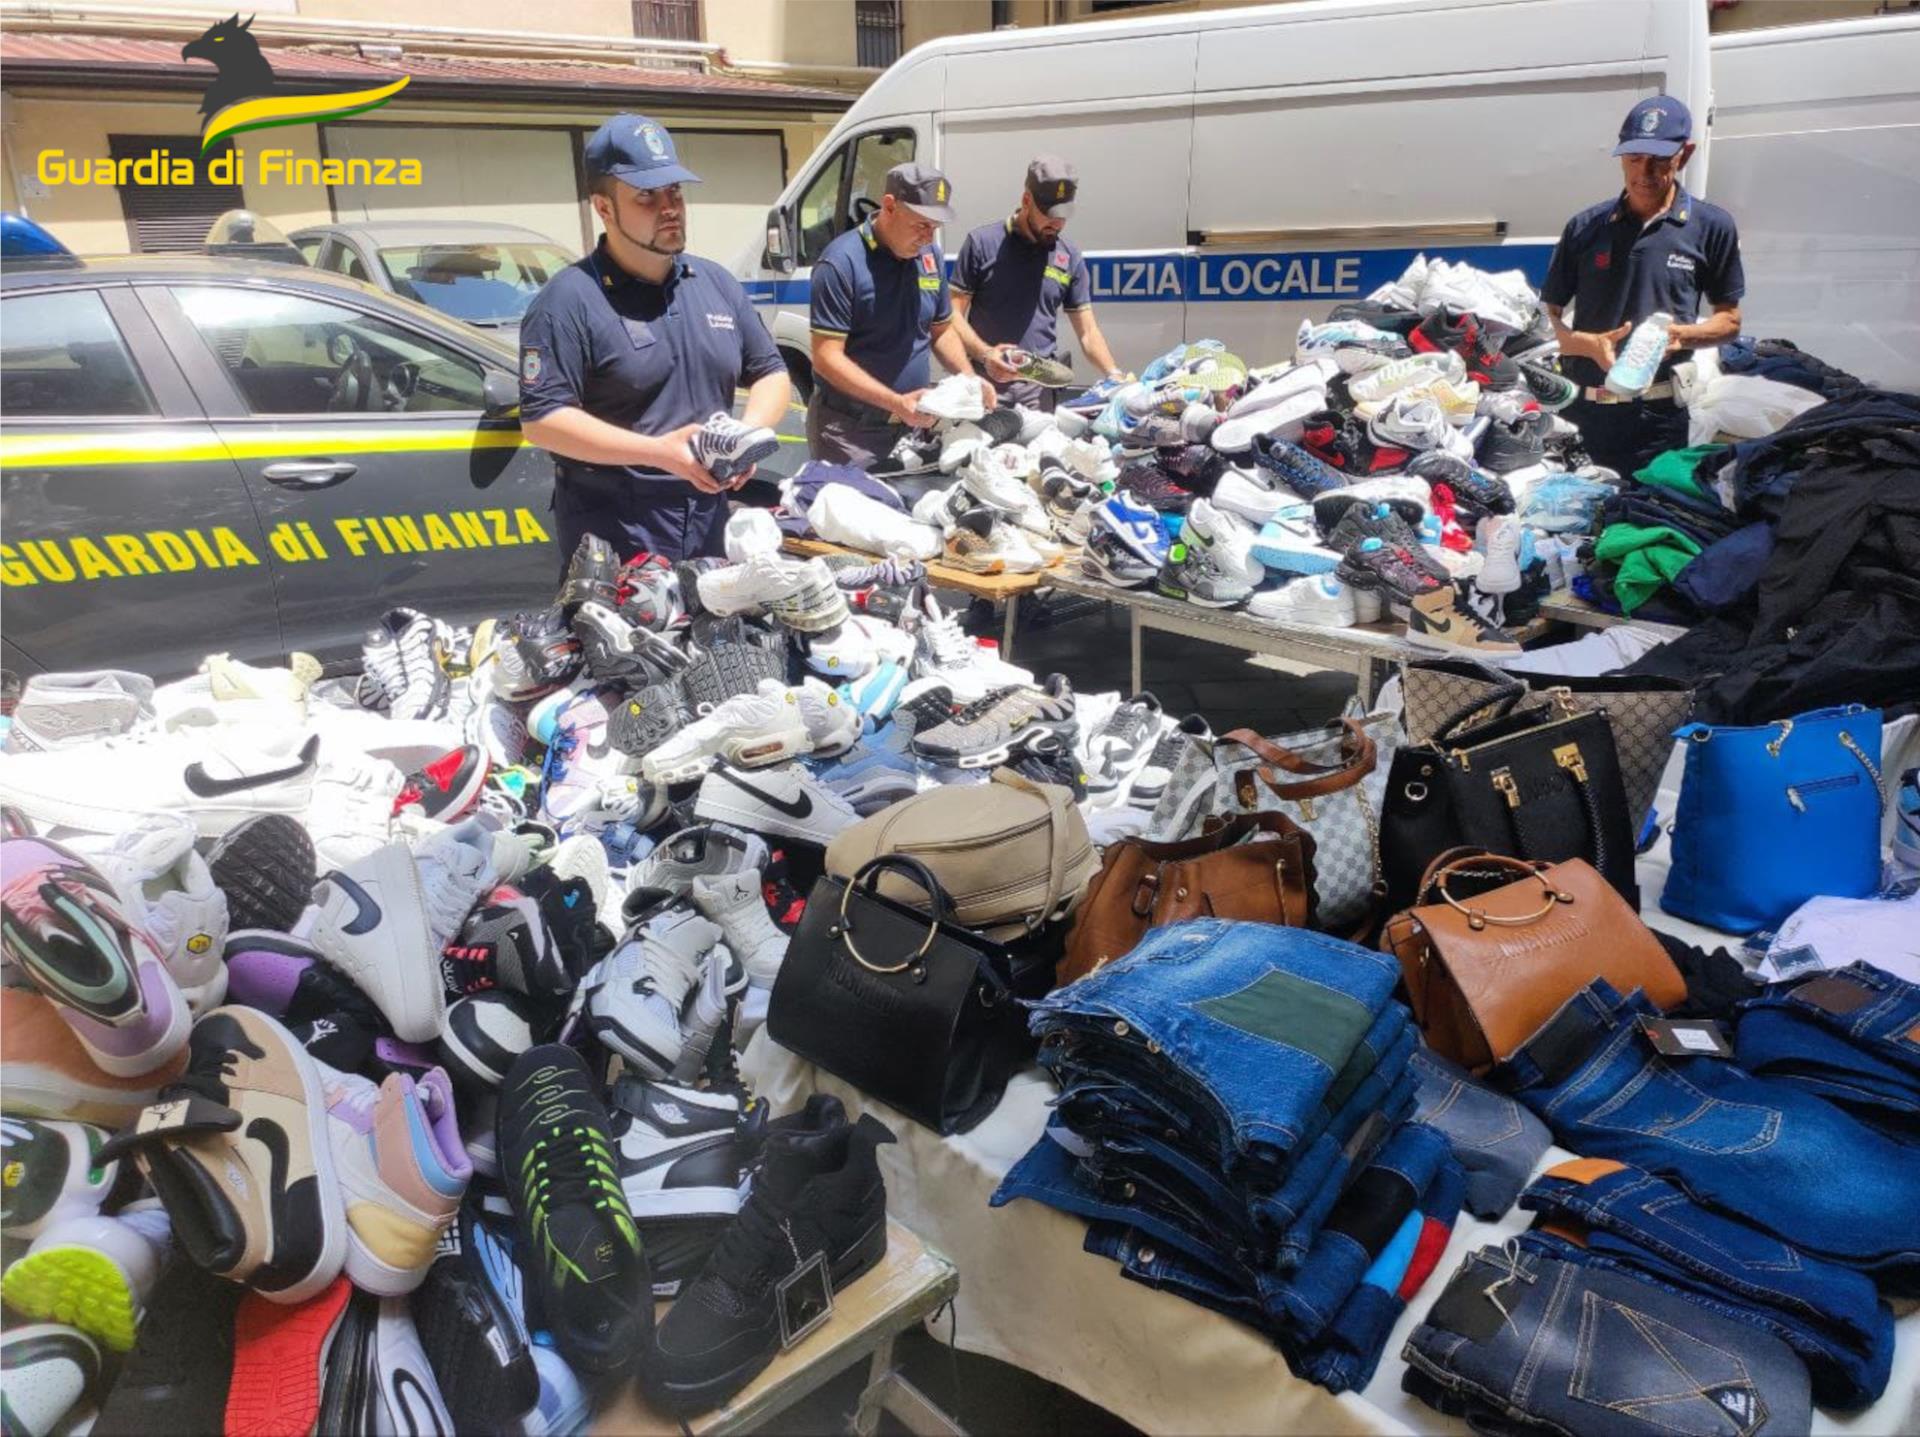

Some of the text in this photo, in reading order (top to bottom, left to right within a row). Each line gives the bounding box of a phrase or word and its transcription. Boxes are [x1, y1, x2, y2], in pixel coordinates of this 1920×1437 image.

[1092, 262, 1182, 296] LIZIA
[1199, 258, 1361, 296] LOCALE
[0, 508, 551, 587] GUARDIA di FINANZA
